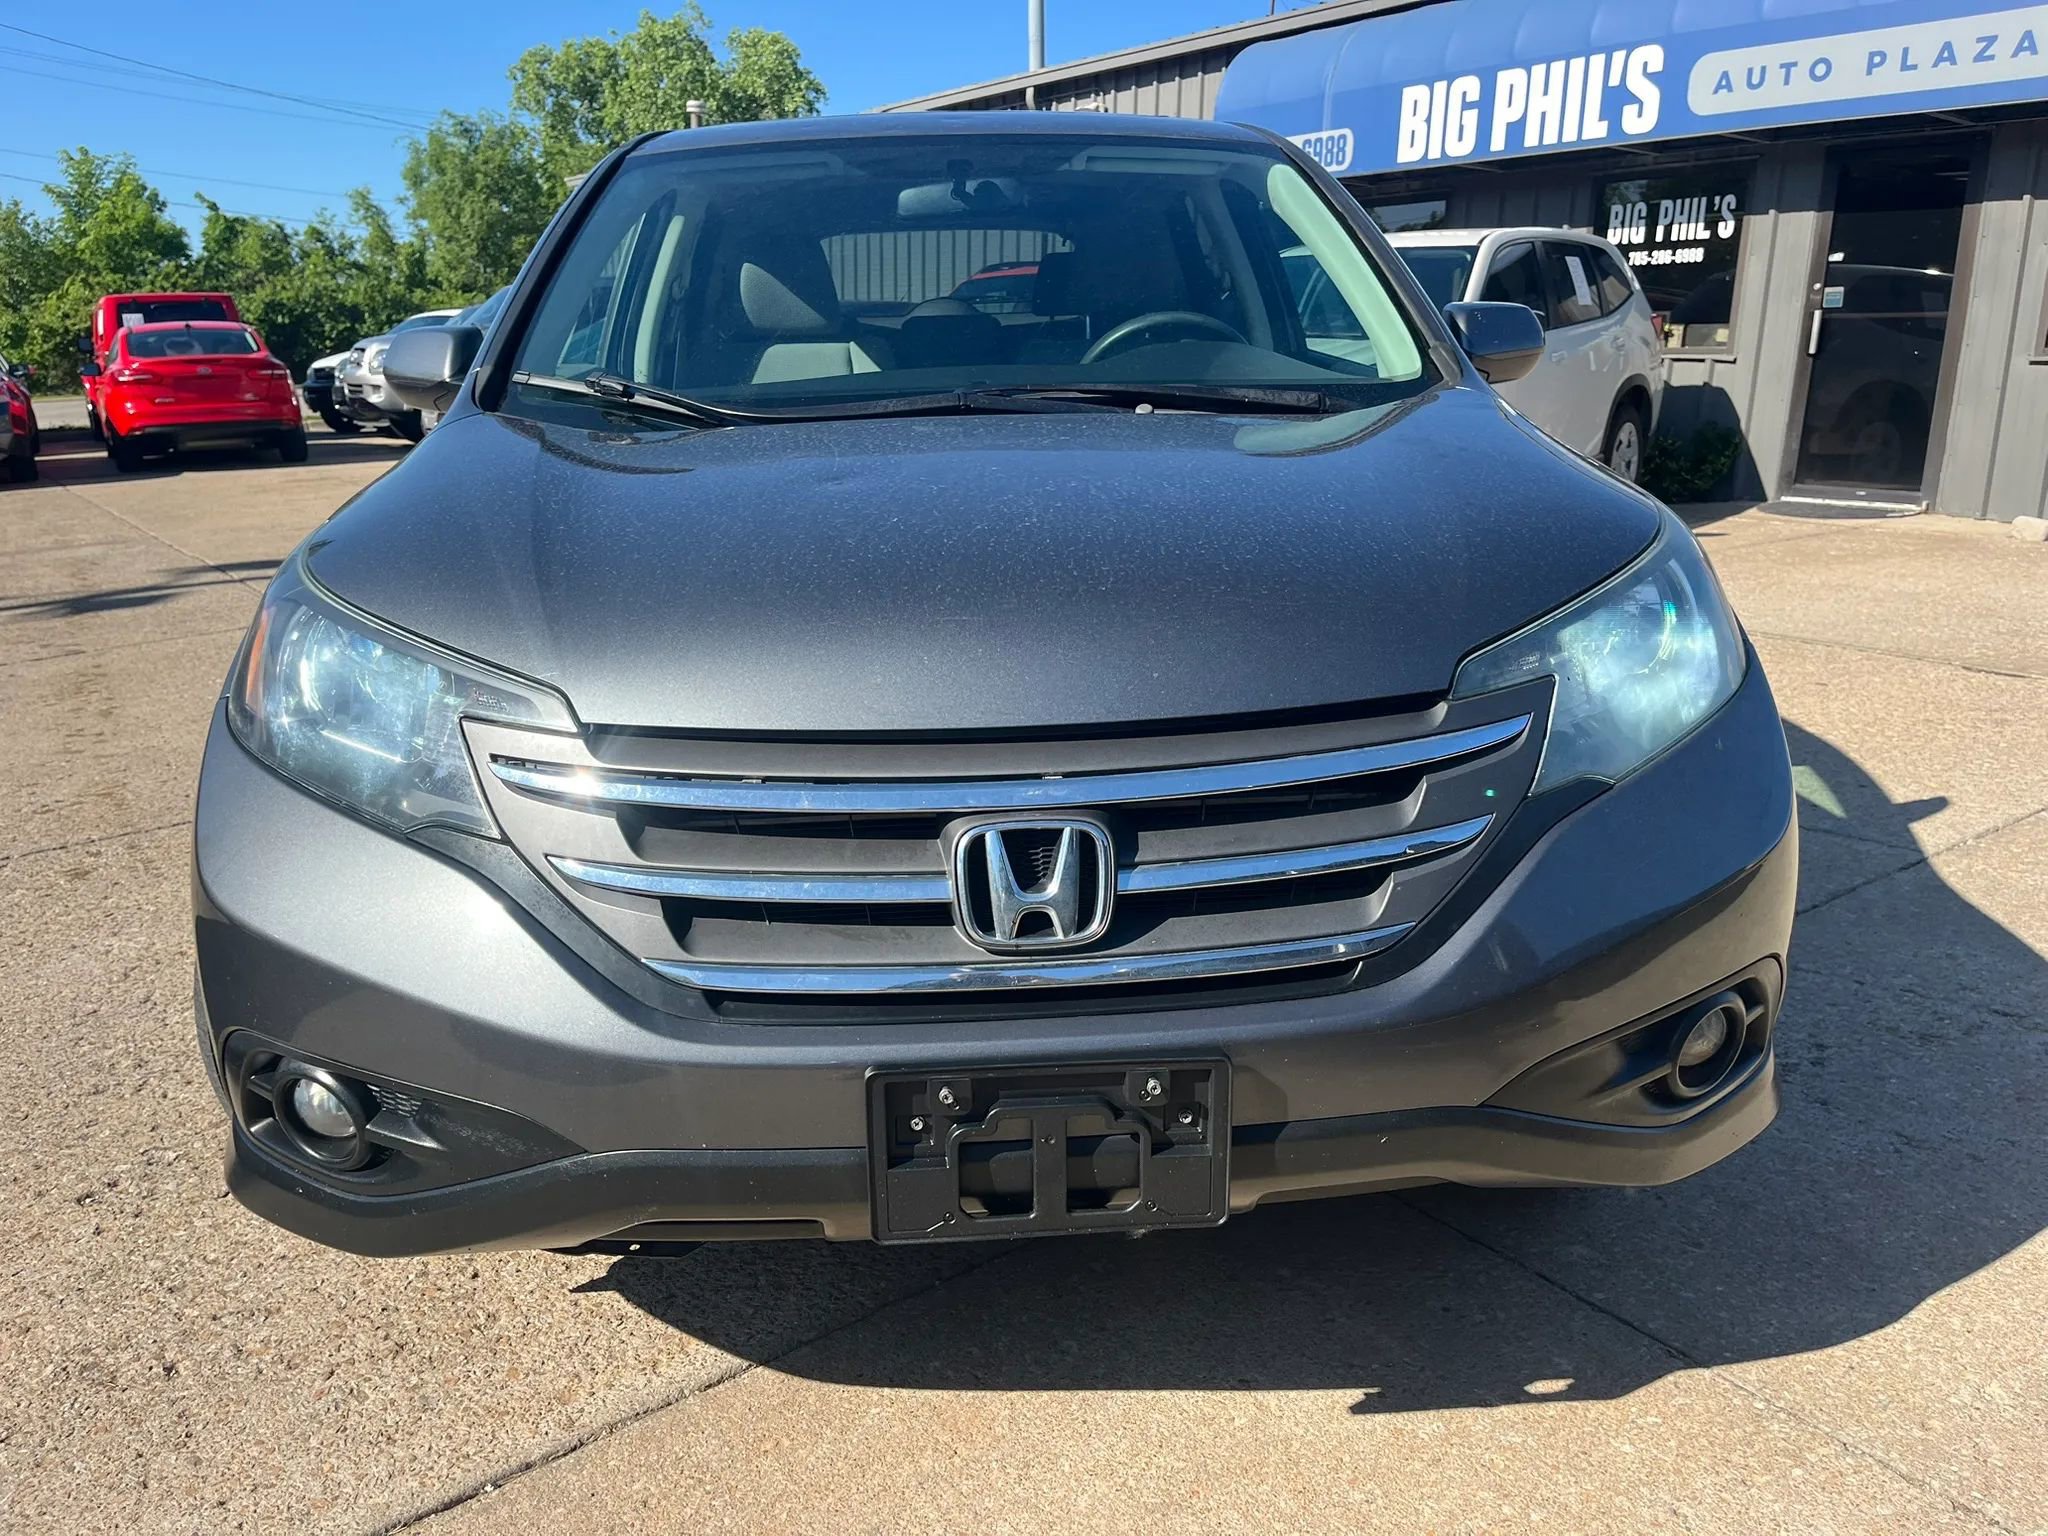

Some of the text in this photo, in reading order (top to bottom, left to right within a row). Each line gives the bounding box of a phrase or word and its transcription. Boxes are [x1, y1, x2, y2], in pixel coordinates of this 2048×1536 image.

[1711, 29, 2039, 95] AUTO PLAZA
[1396, 44, 1665, 163] BIG PHIL'S
[1606, 194, 1737, 245] BIG PHIL'S
